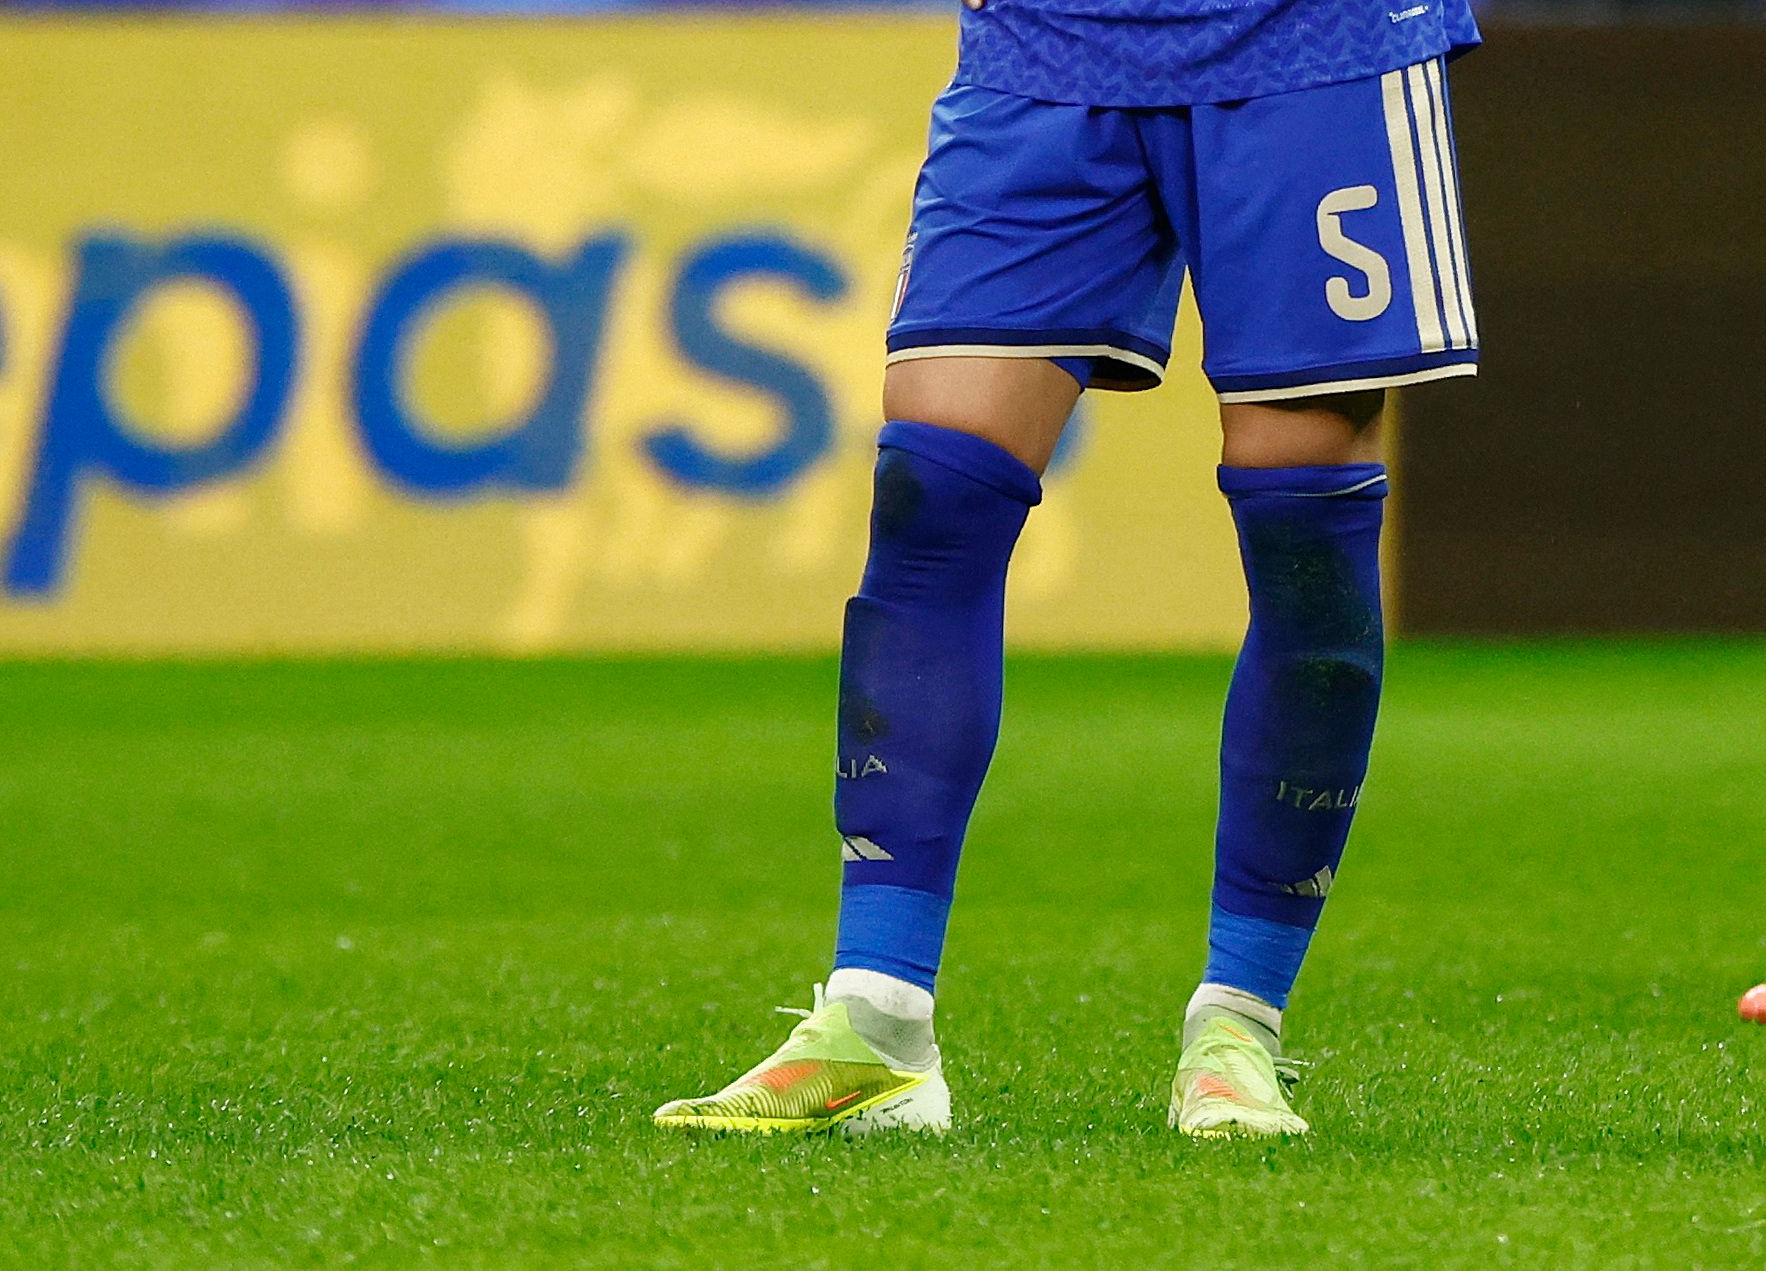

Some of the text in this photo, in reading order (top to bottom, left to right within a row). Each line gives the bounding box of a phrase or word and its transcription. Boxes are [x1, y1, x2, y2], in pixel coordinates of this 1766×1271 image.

[1317, 185, 1392, 321] 5
[0, 220, 1090, 600] pas
[1276, 780, 1360, 810] ITALI
